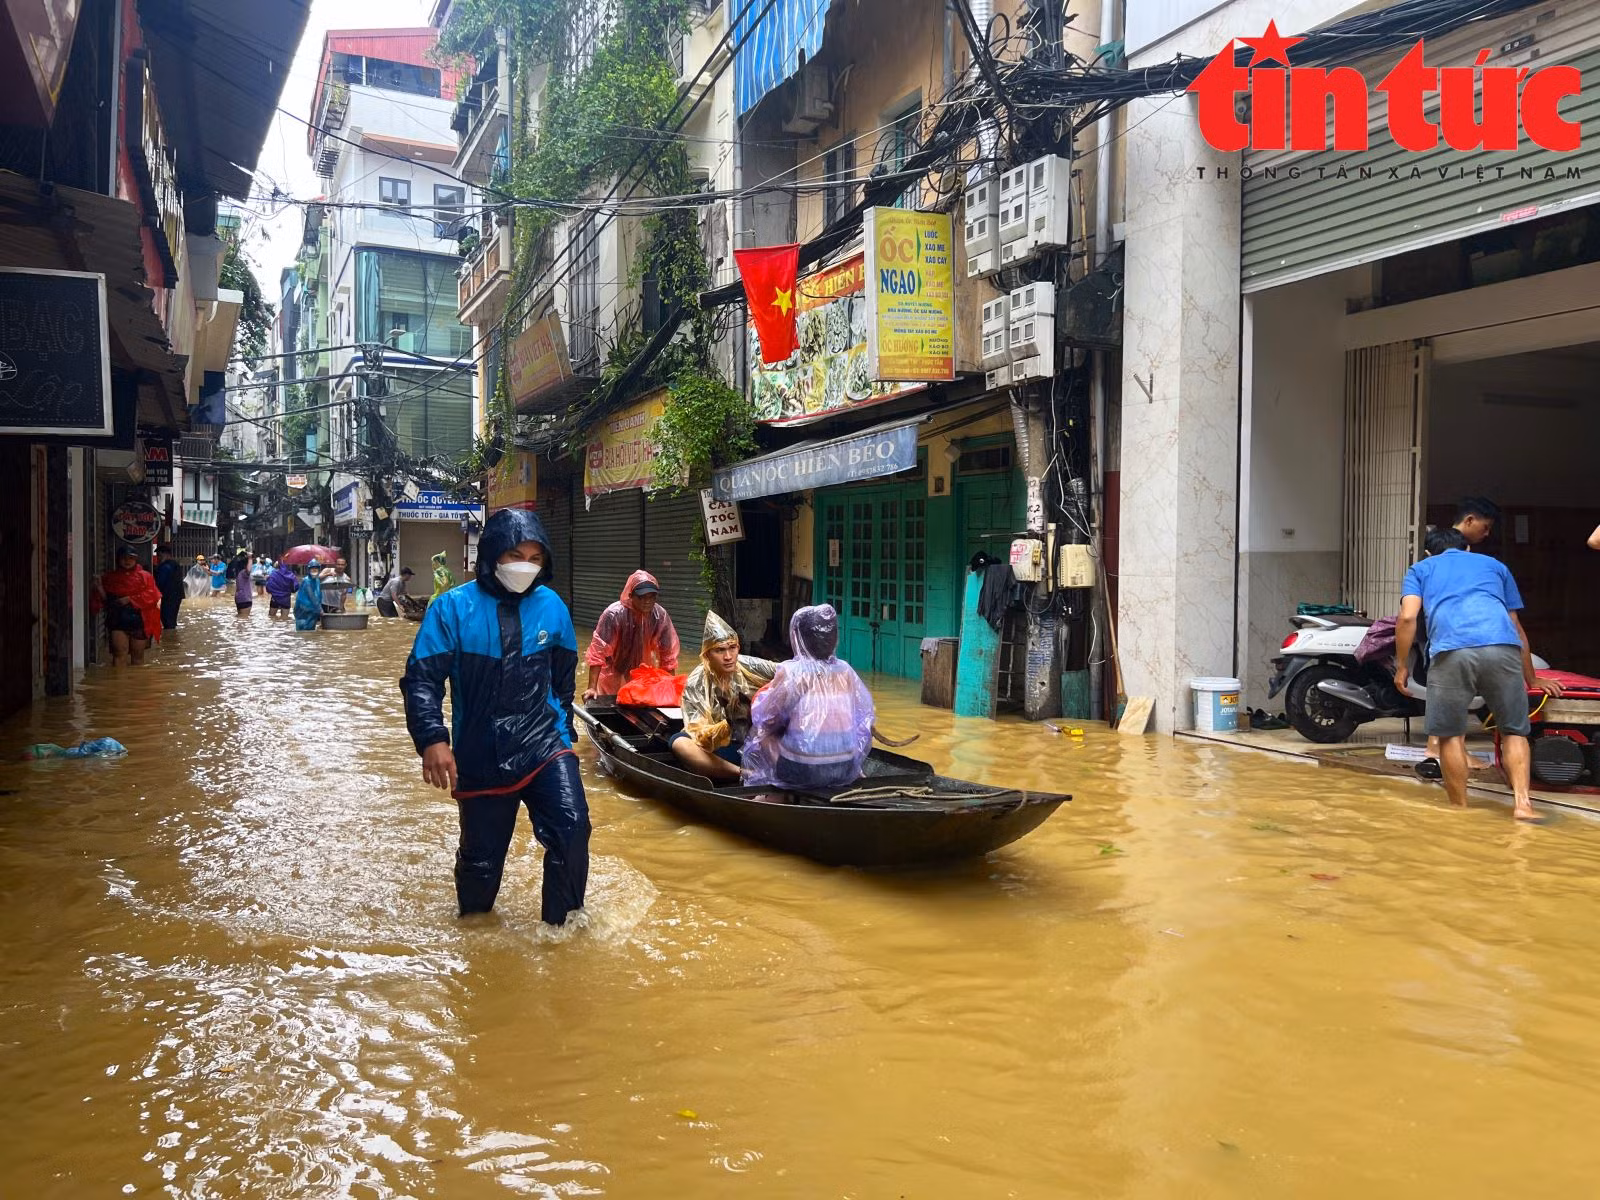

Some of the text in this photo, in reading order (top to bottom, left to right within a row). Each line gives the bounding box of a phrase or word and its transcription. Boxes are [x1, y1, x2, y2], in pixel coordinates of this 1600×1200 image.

[880, 225, 914, 264] ỐC
[880, 268, 916, 295] NGAO
[849, 438, 896, 466] BÉO
[710, 524, 739, 536] NAM
